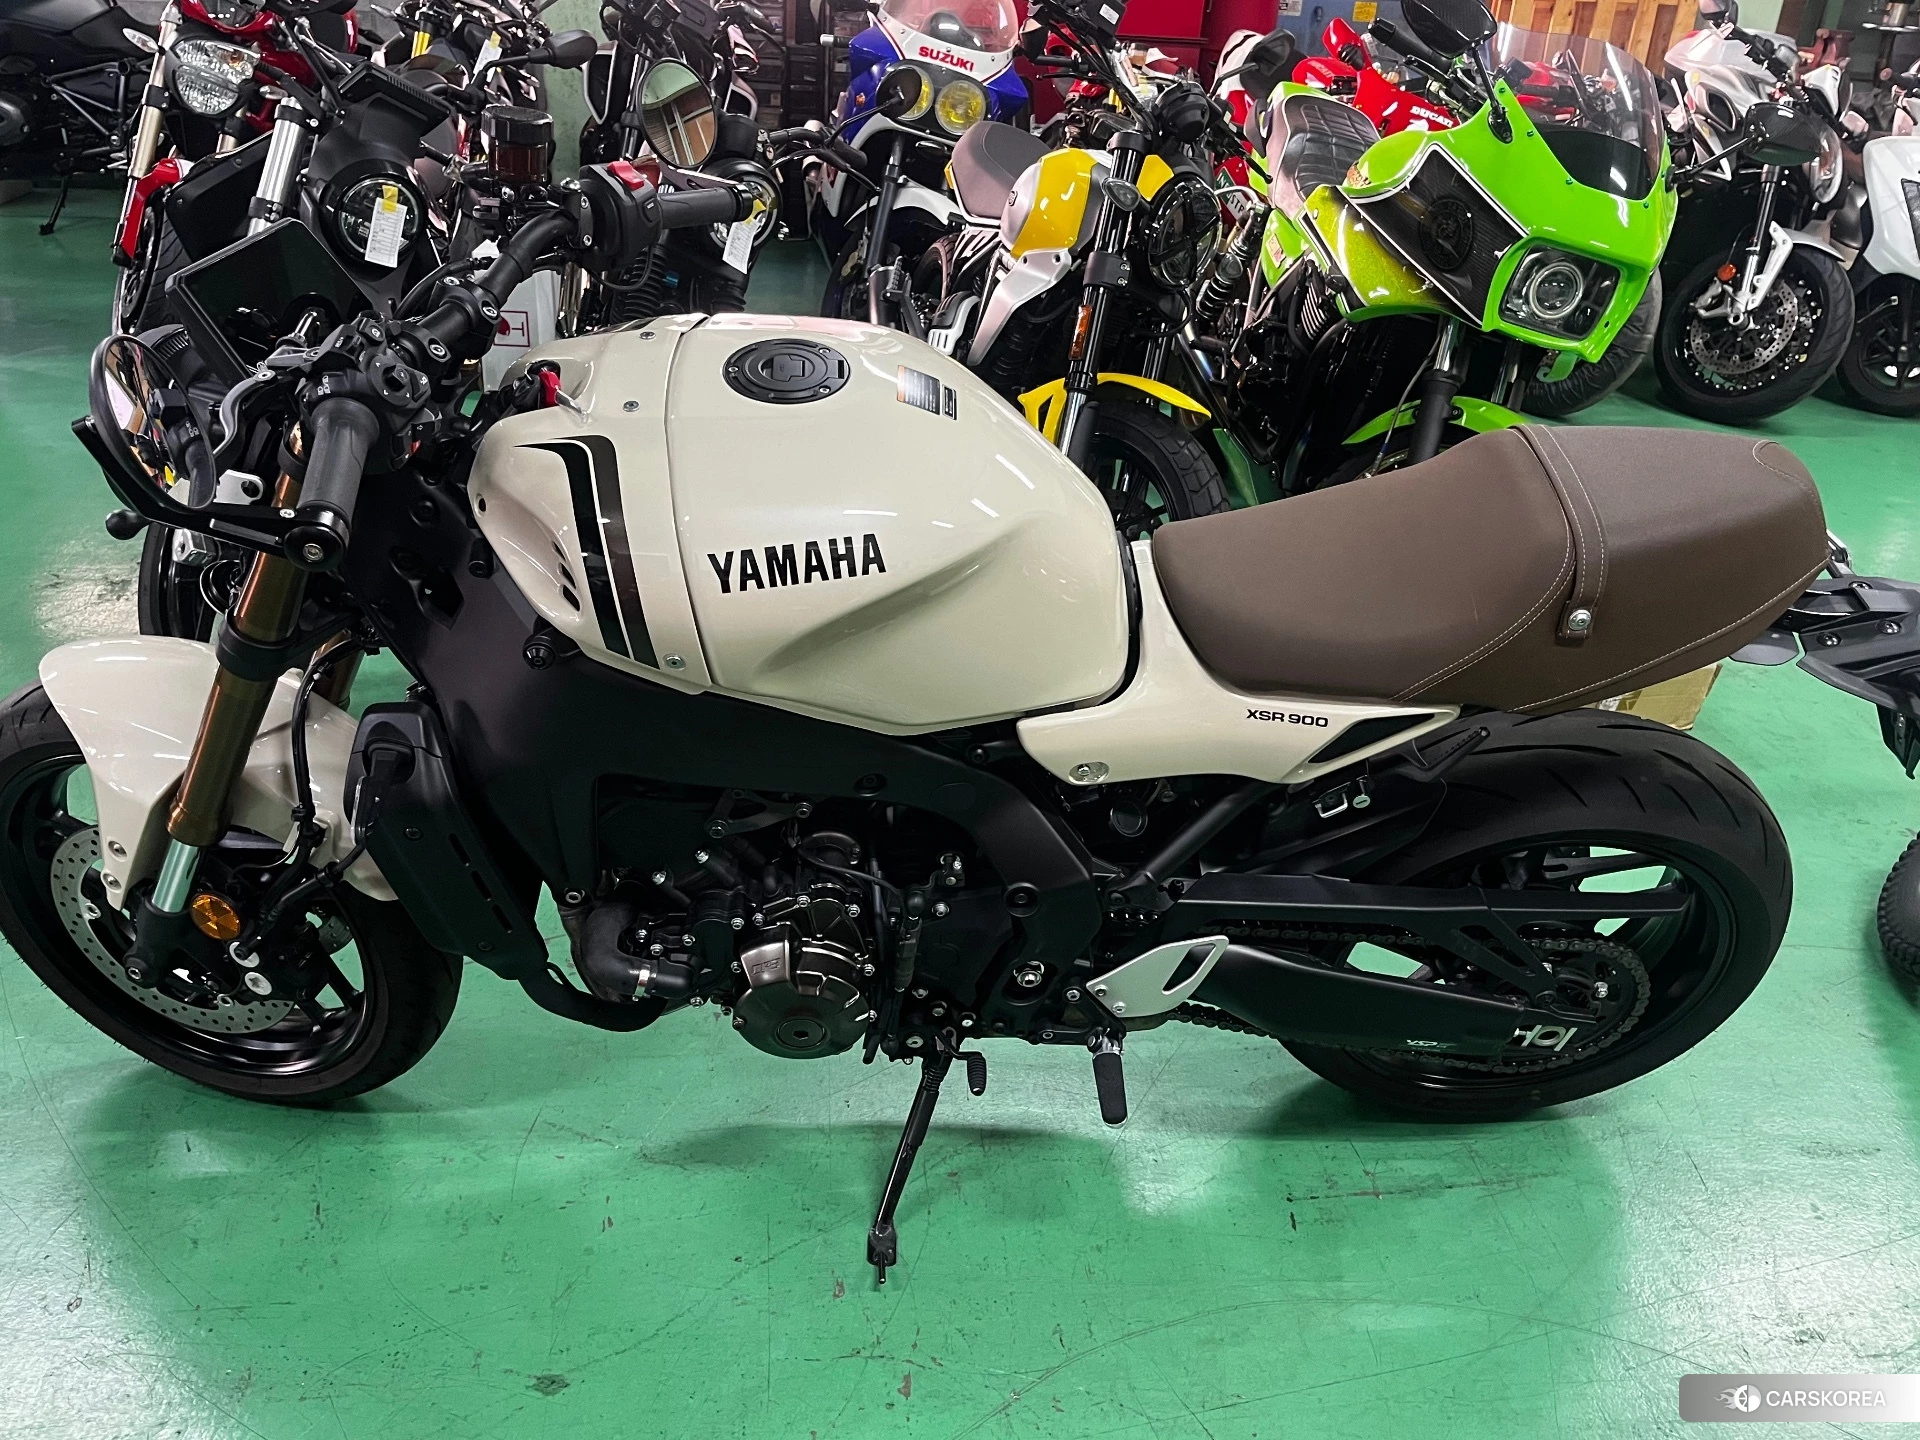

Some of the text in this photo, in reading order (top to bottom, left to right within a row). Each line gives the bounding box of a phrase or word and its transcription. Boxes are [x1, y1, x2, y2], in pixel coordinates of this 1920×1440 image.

[919, 46, 974, 72] SUZUKI
[1409, 105, 1454, 128] DUCATI
[707, 533, 887, 594] YAMAHA
[1246, 708, 1329, 727] XSR 900
